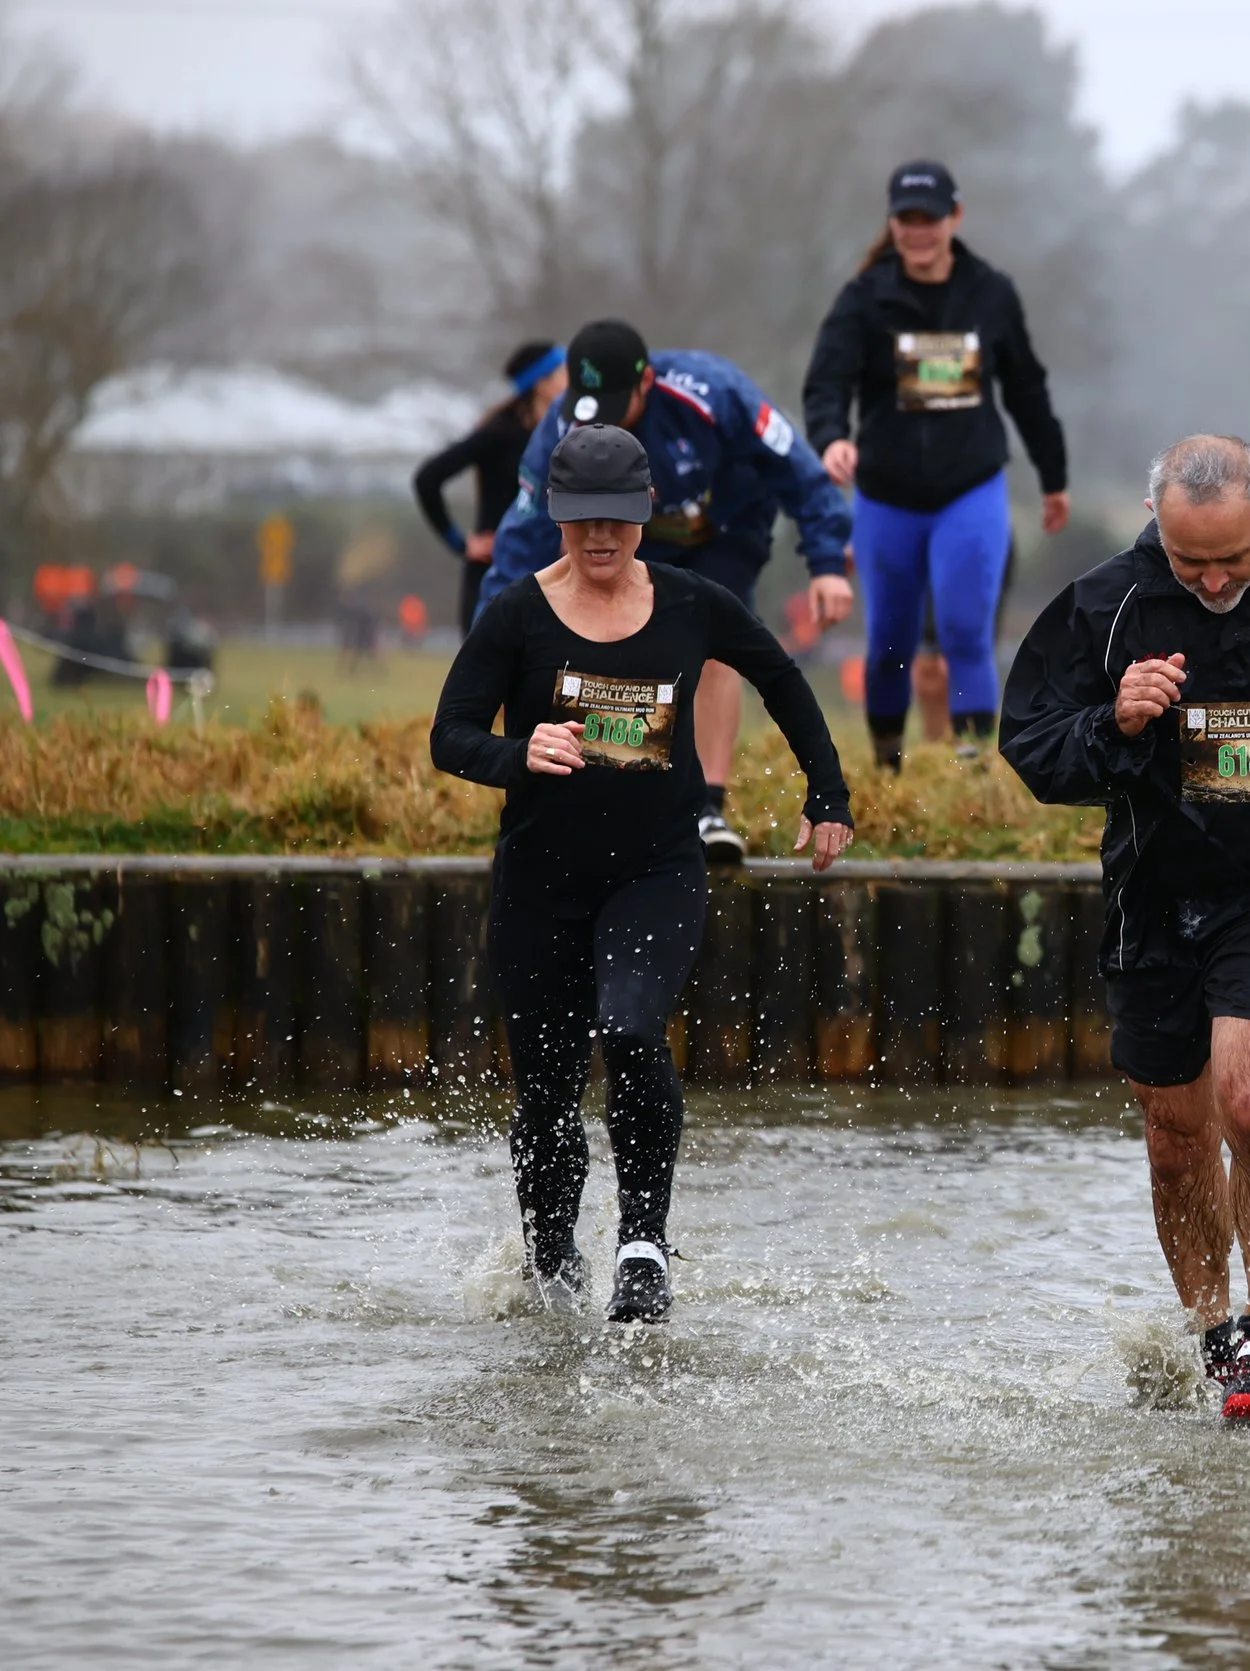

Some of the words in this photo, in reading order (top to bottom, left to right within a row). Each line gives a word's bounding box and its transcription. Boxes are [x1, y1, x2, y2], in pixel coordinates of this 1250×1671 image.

[584, 680, 609, 690] TOUGH
[611, 683, 626, 691] GUY
[626, 684, 640, 692] AND
[582, 688, 654, 703] CHALLENGE
[583, 713, 644, 747] 6186
